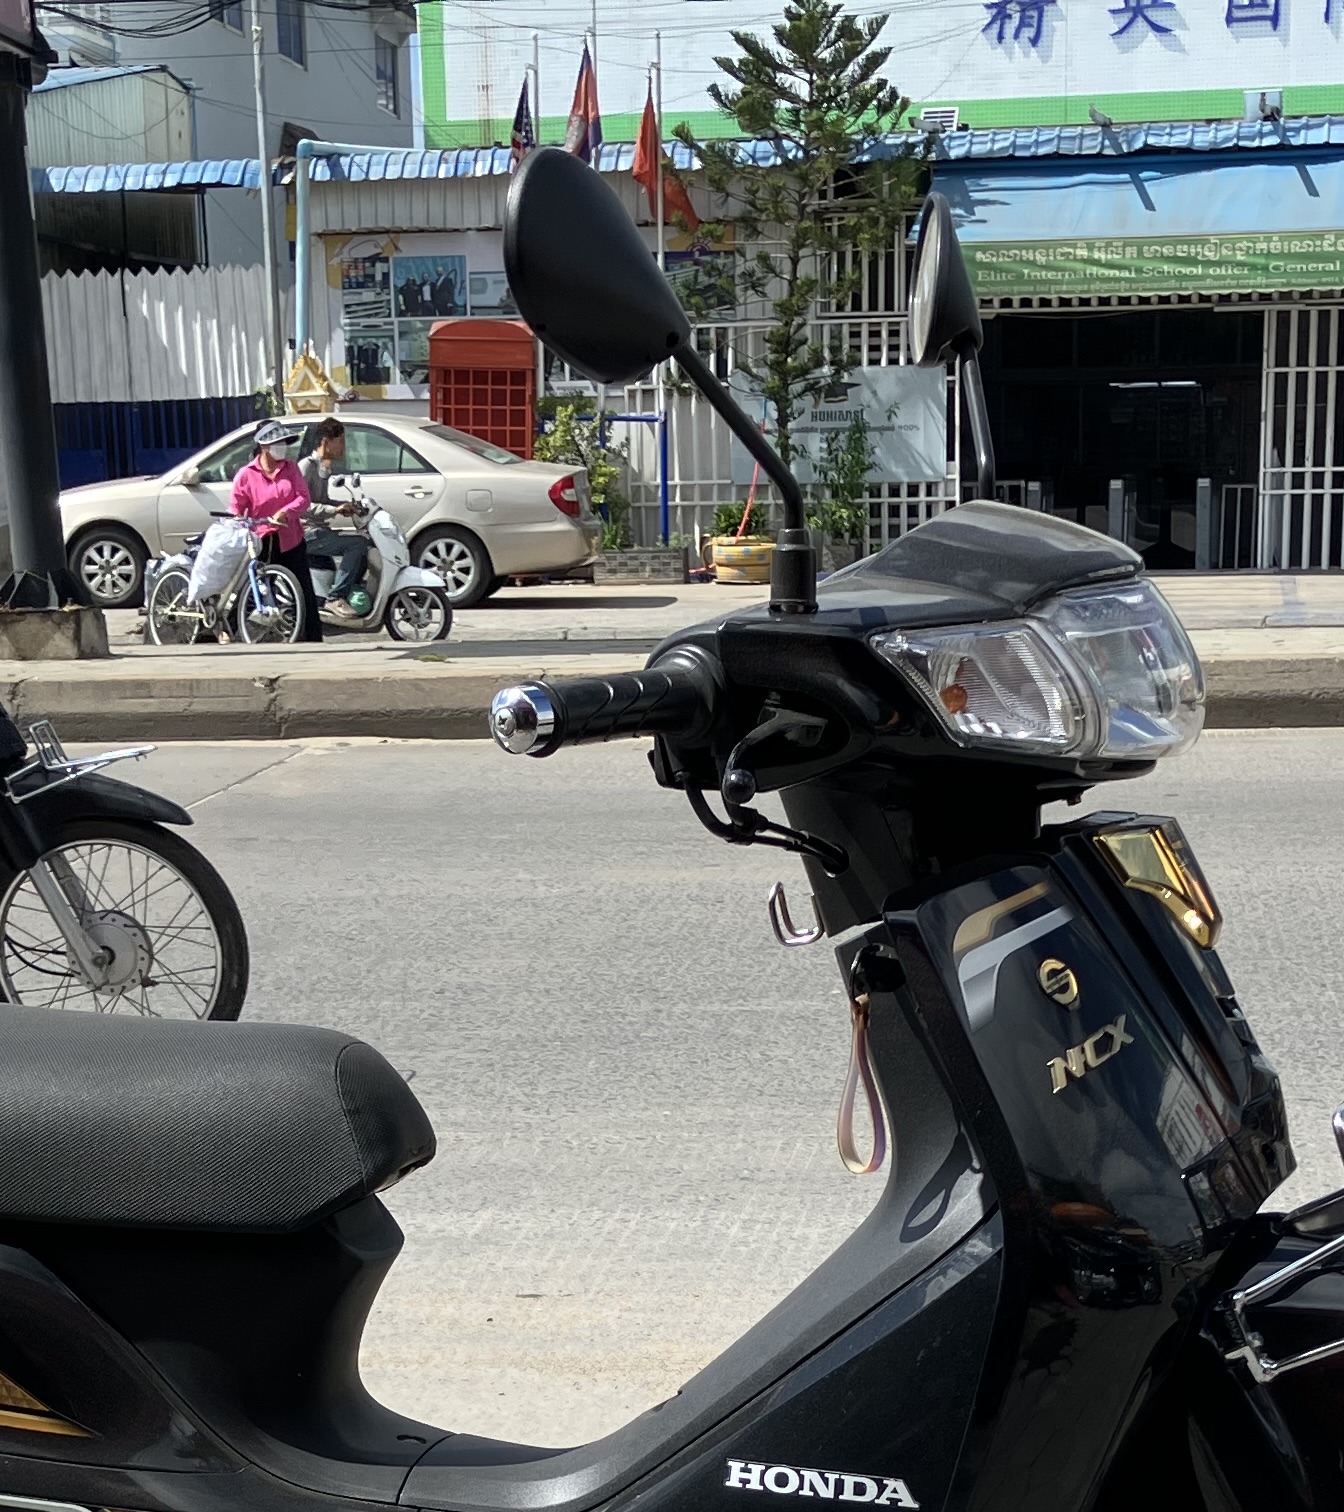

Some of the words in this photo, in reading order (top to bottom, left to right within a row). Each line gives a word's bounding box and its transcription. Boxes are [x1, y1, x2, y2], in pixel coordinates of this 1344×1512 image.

[977, 270, 1016, 282] Elite
[1022, 267, 1135, 281] International
[1142, 265, 1202, 278] School
[1209, 263, 1250, 276] offer
[1269, 261, 1340, 273] General
[1046, 1014, 1134, 1094] NCX
[725, 1459, 919, 1510] HONDA
